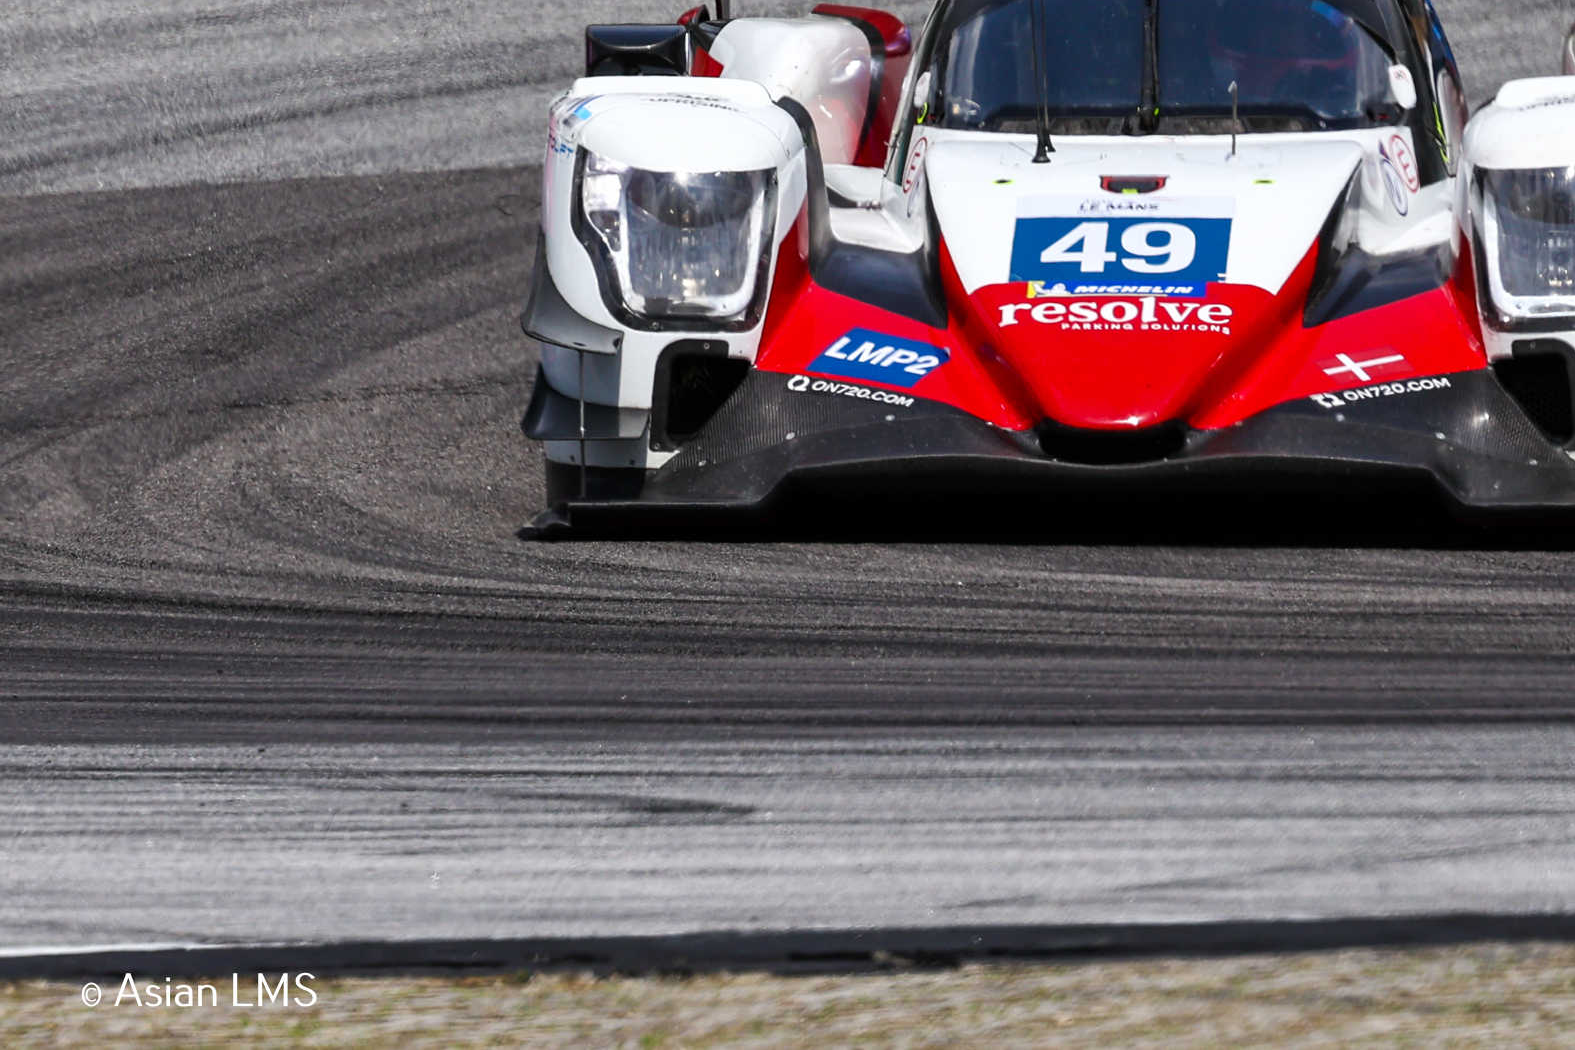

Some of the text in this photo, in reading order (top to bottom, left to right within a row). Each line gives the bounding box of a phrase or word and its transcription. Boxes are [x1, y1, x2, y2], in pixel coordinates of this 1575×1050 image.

[1040, 221, 1196, 274] 49
[1074, 285, 1193, 294] MICHELIN
[998, 297, 1233, 327] resolve
[1061, 323, 1230, 335] PARKING SOLUTIONS
[824, 336, 940, 375] LMP2
